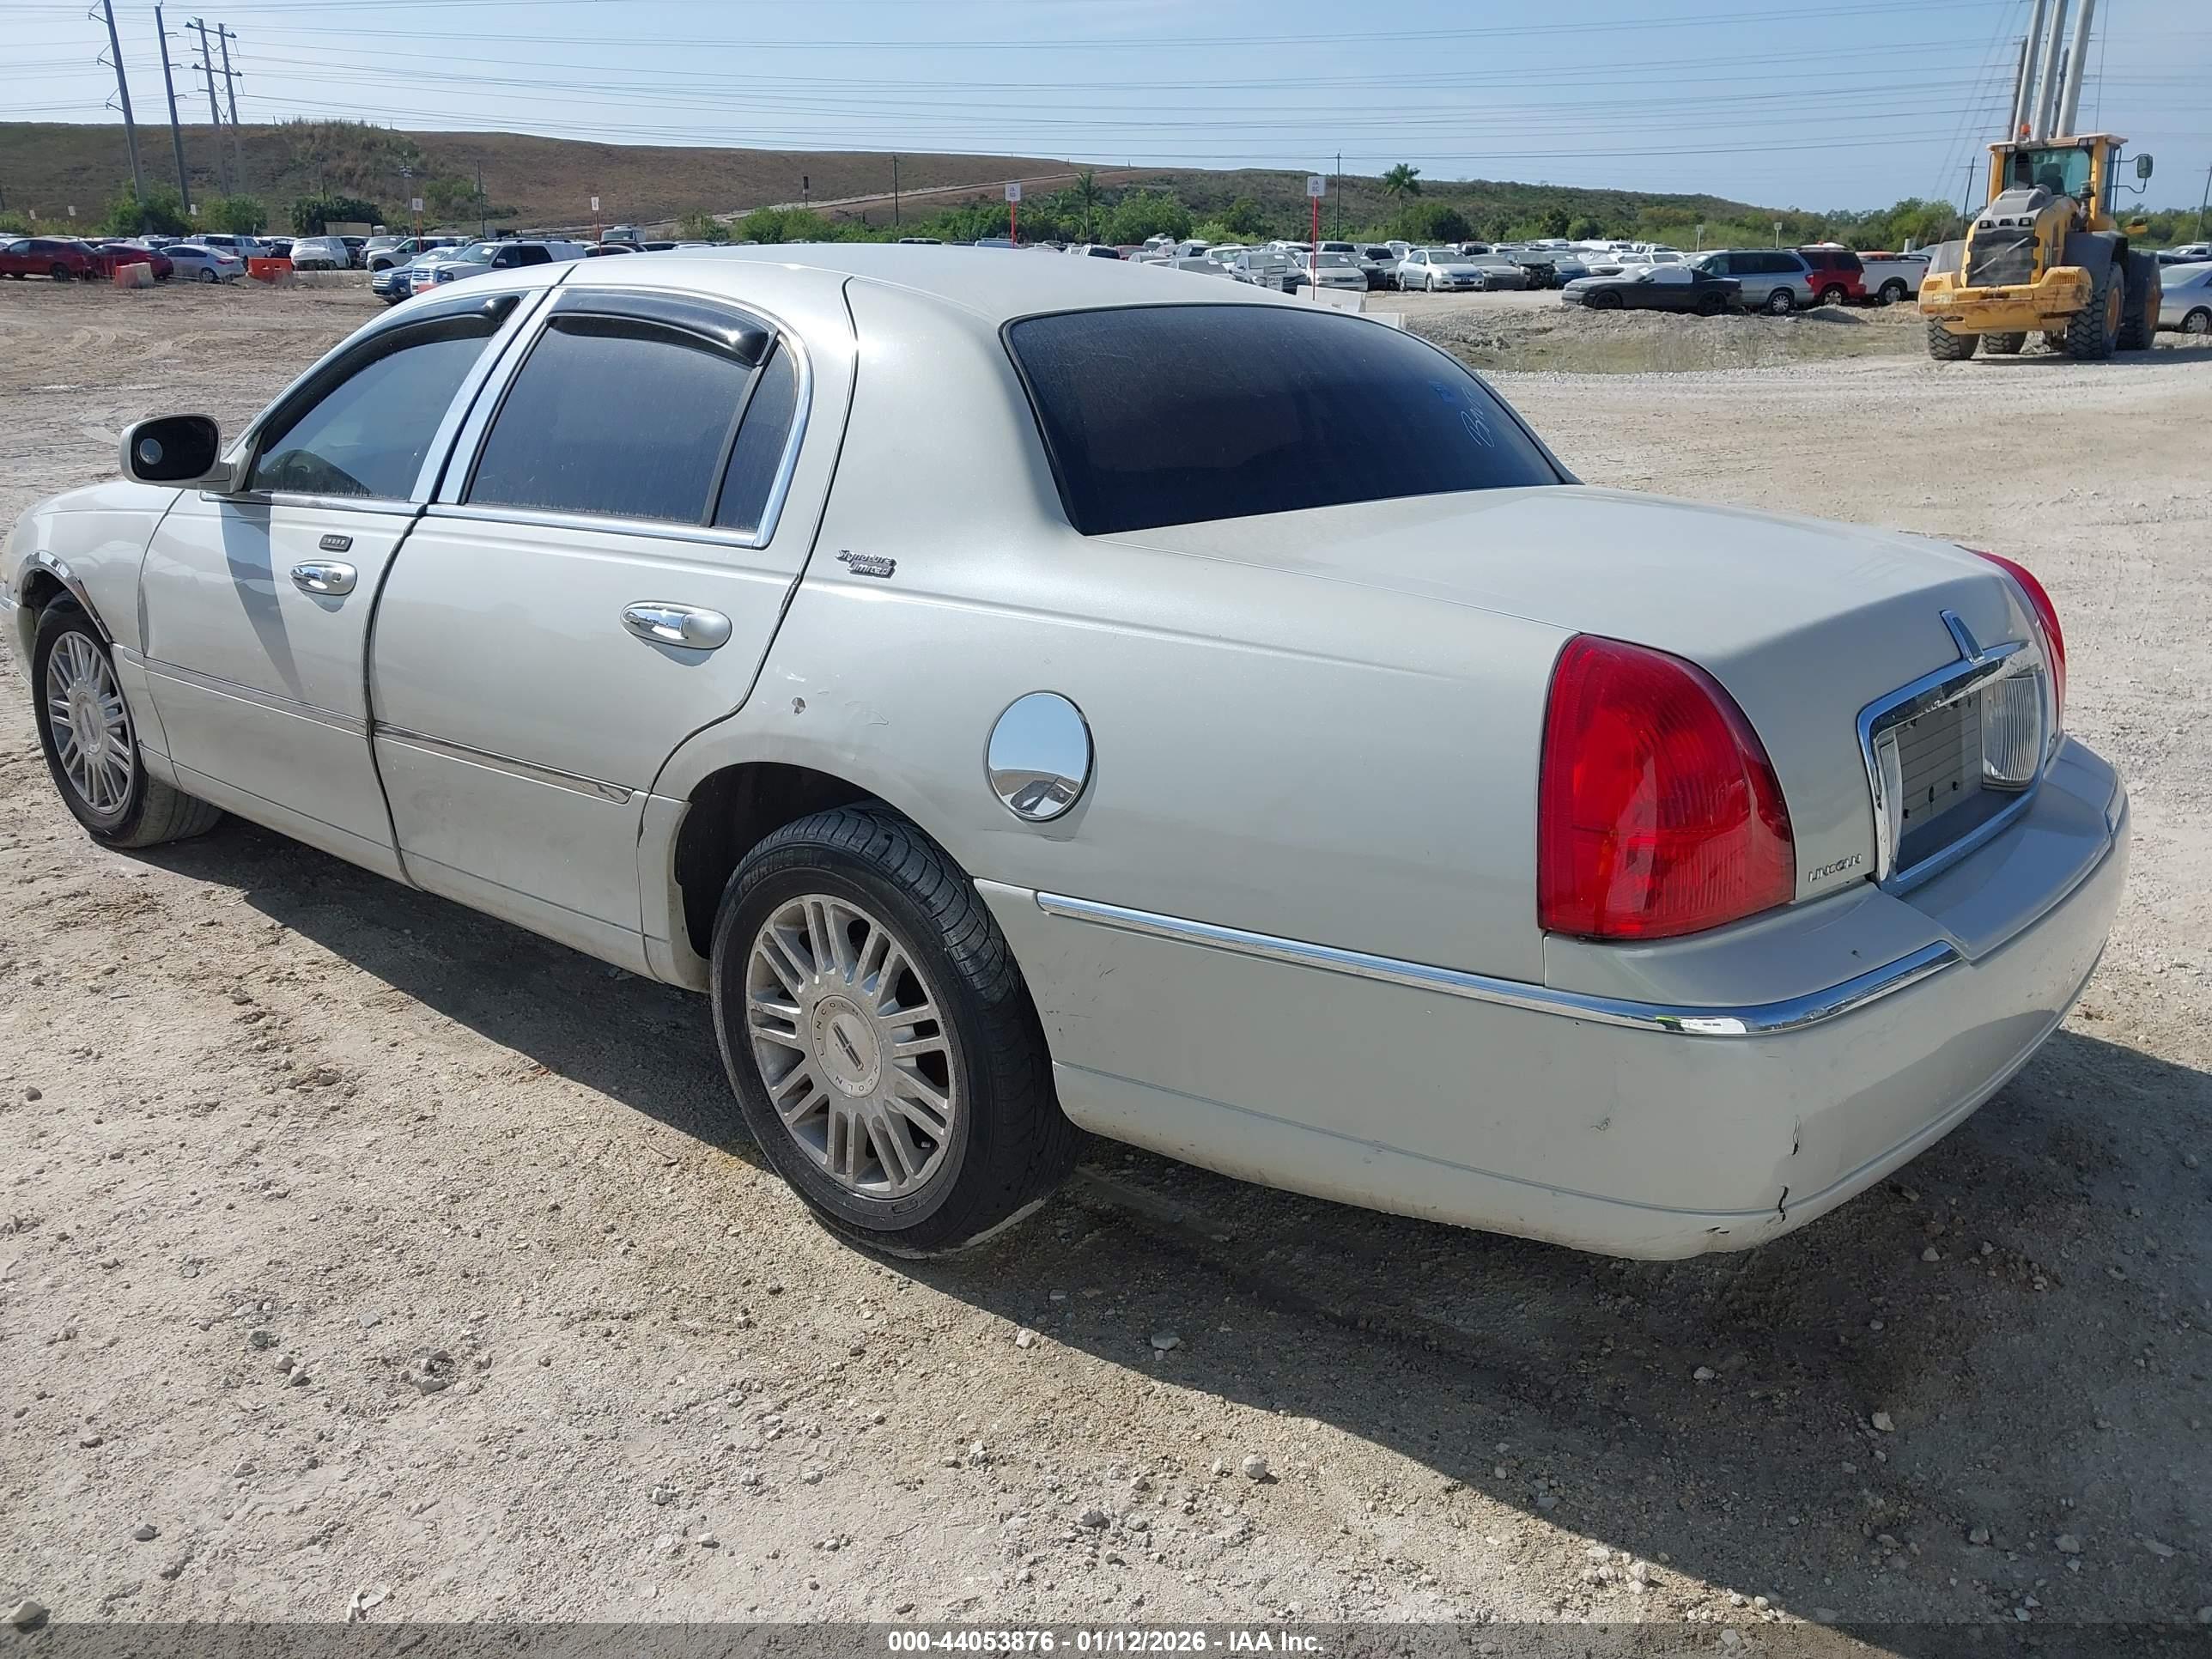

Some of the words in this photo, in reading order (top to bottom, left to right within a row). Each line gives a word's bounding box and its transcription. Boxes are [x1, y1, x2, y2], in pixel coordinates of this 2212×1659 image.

[837, 550, 894, 566] Signature
[848, 562, 891, 576] Limited
[1808, 853, 1863, 883] LINCOLN
[816, 1002, 859, 1057] LINCOLN
